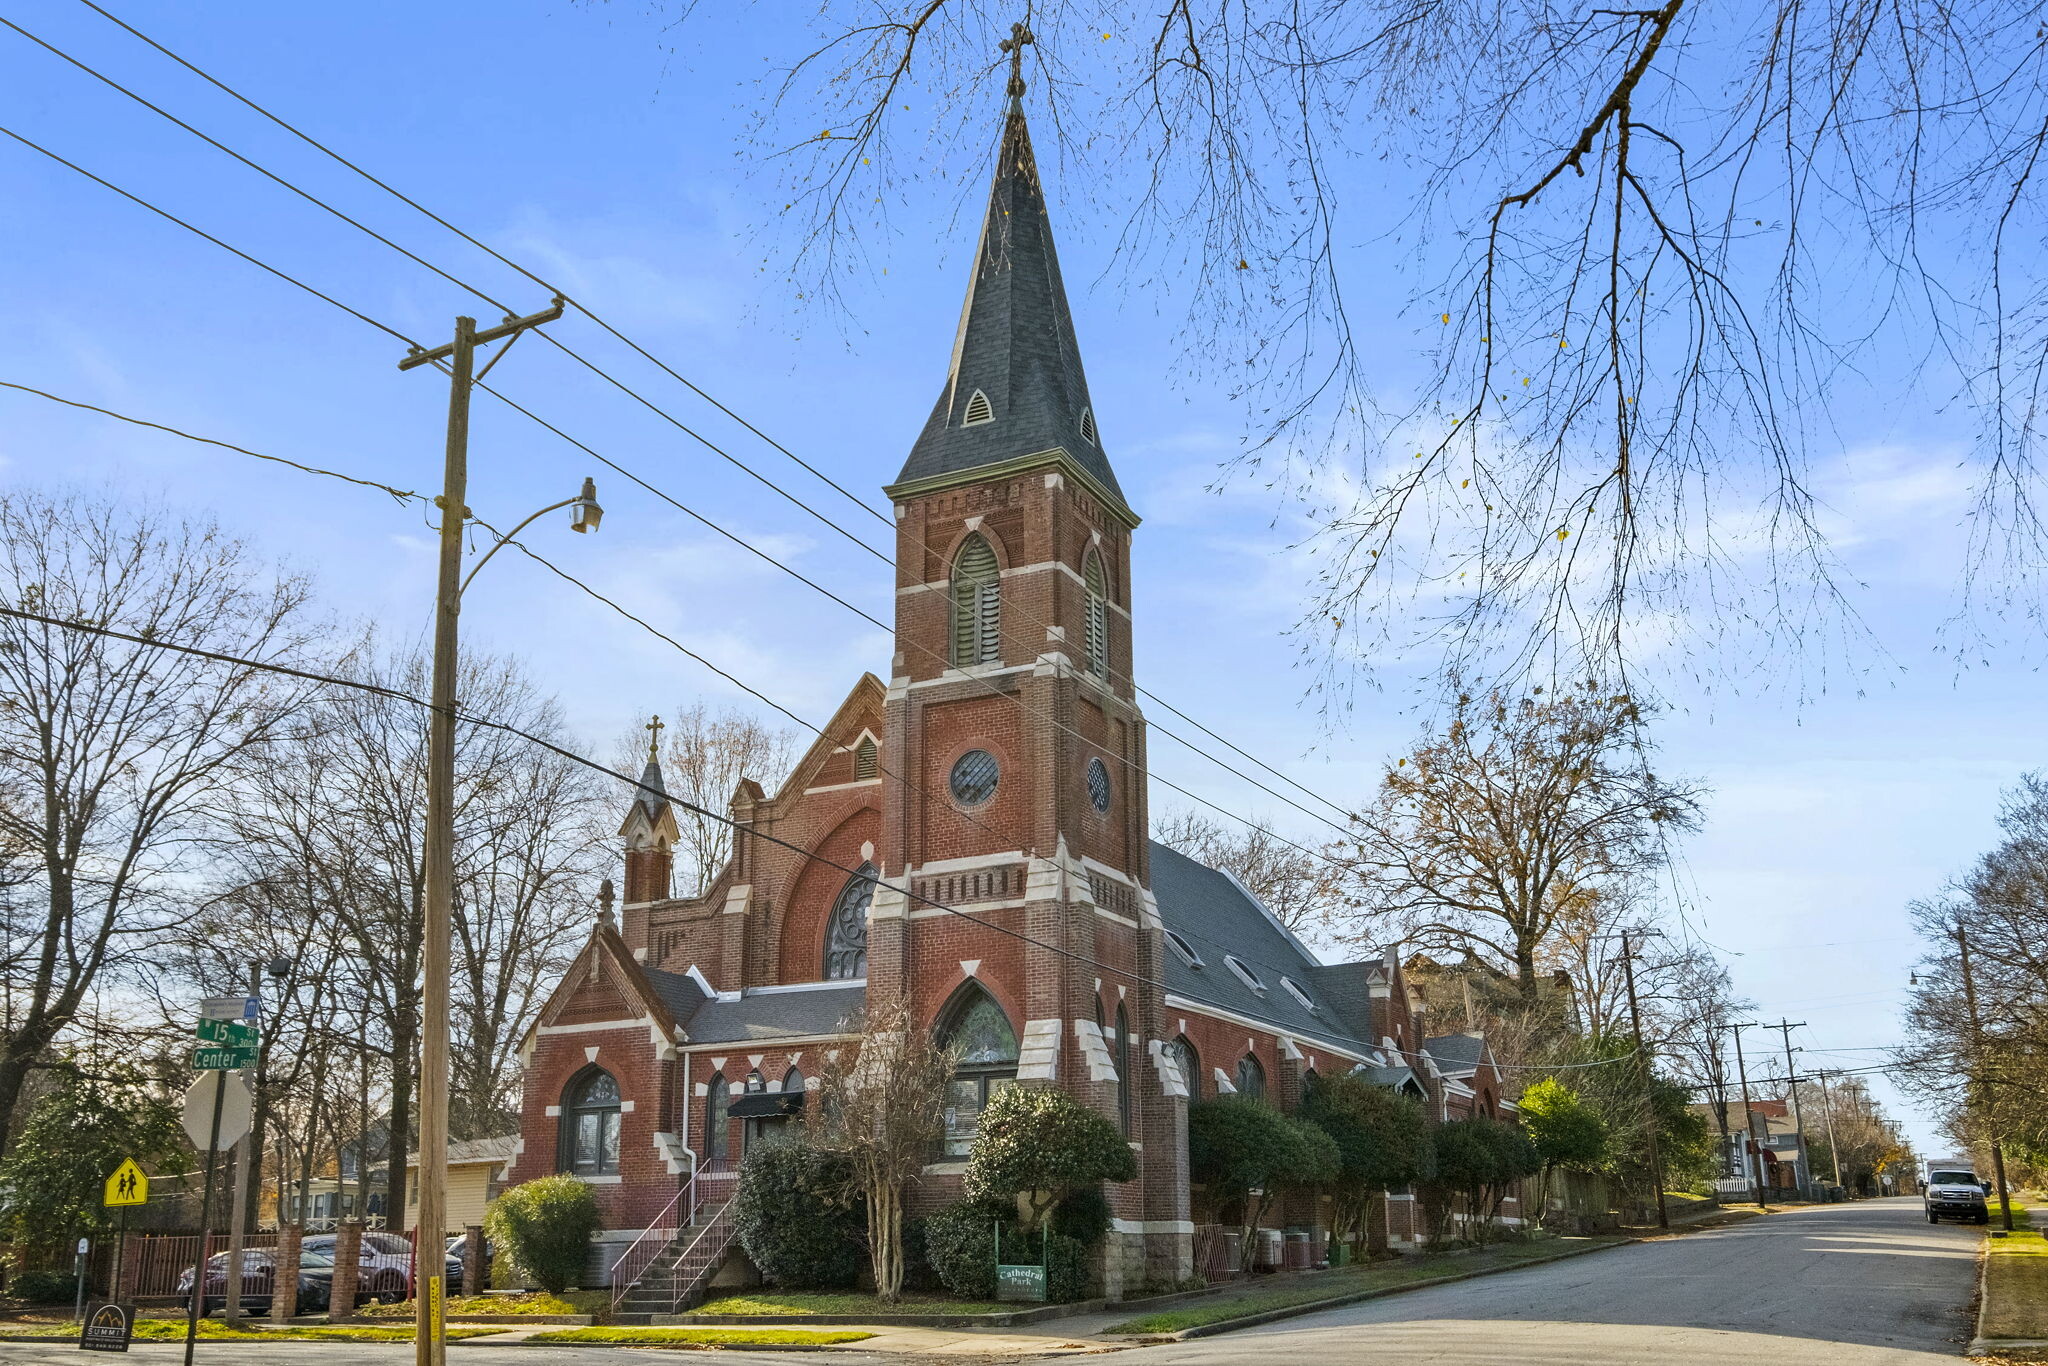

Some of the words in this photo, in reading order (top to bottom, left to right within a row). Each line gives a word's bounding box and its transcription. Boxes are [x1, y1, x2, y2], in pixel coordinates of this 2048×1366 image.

[205, 1020, 211, 1028] W
[246, 1028, 255, 1037] St
[194, 1051, 237, 1067] Center
[249, 1048, 257, 1056] St
[240, 1059, 256, 1068] 1500
[999, 1269, 1043, 1280] Cathedral
[88, 1328, 126, 1336] SUMMIT
